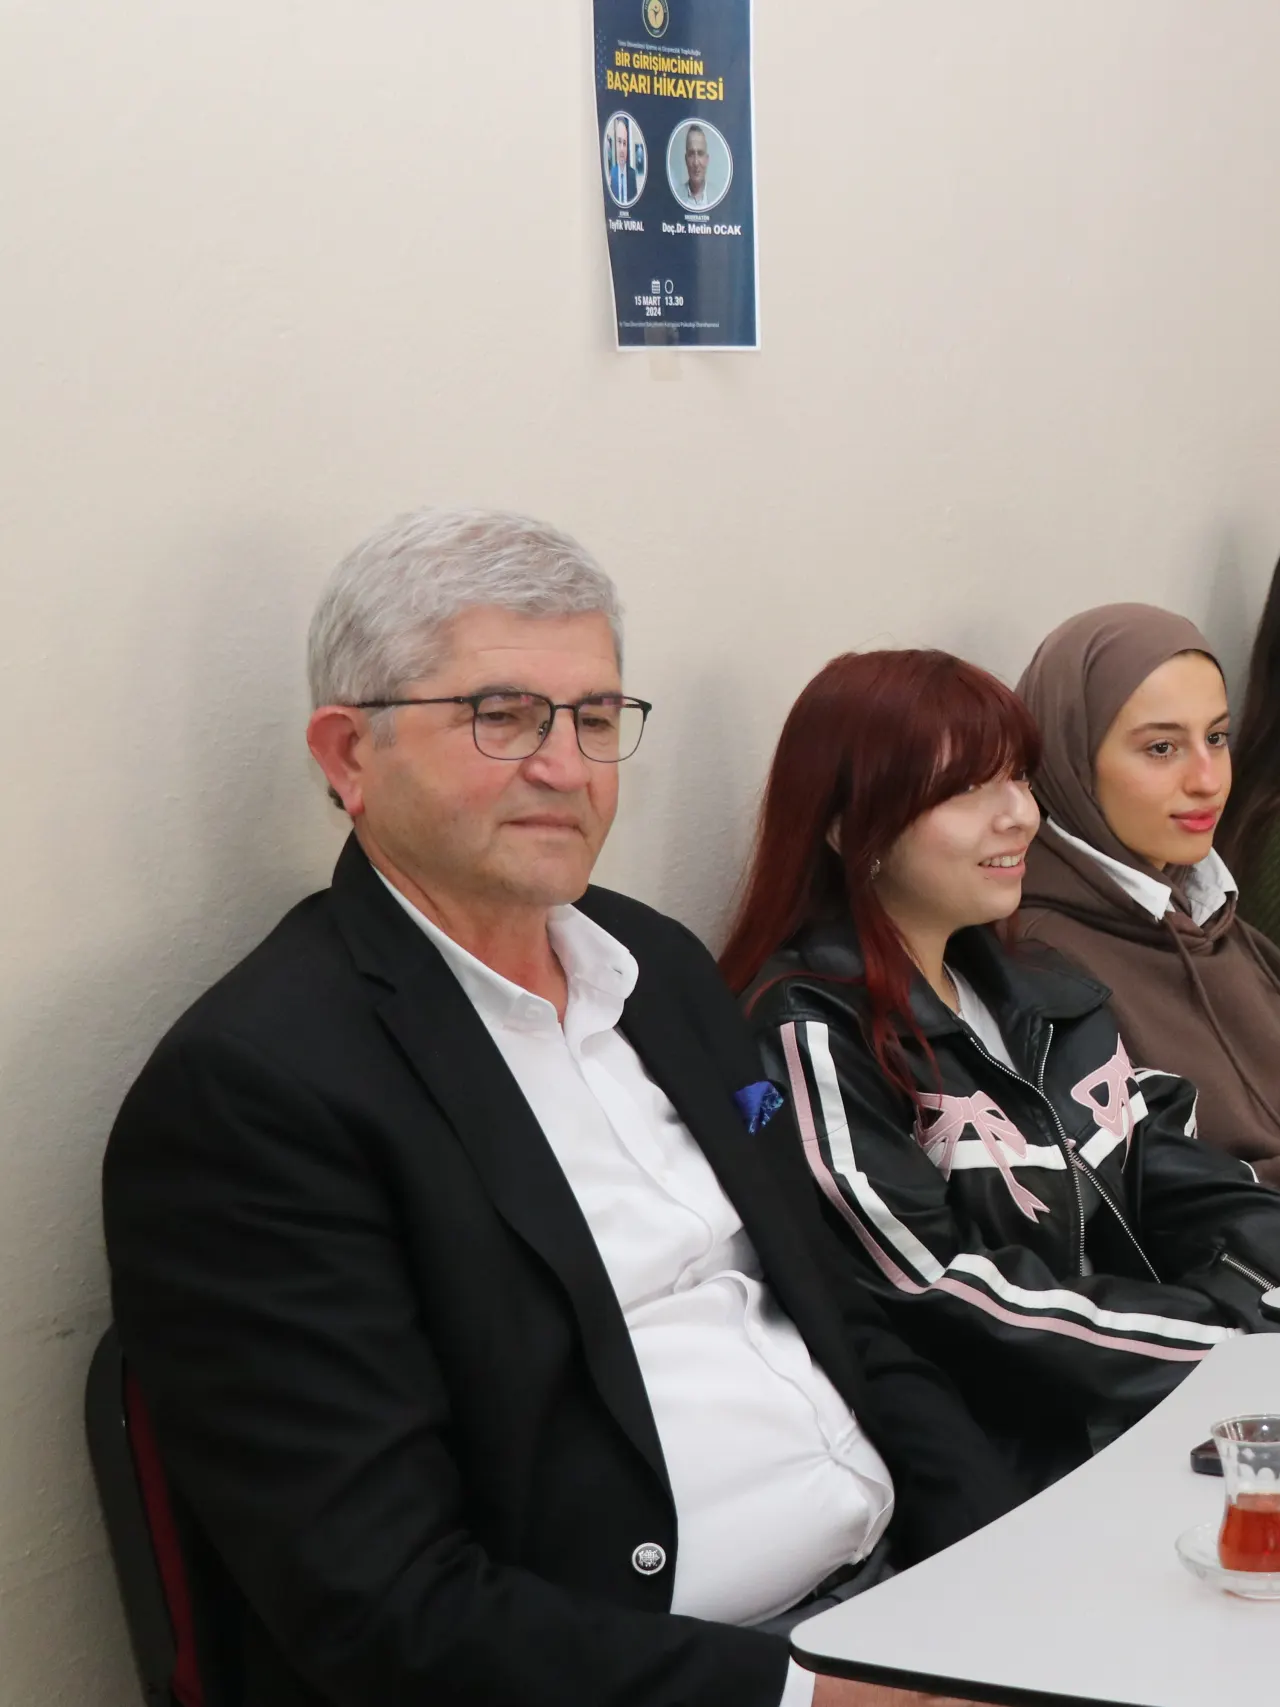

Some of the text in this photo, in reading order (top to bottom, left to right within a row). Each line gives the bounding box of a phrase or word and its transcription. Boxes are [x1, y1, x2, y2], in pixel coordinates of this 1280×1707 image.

[615, 49, 704, 76] BİR GİRİŞİMCİNİN
[607, 70, 724, 101] BAŞARI HİKAYESİ
[624, 220, 645, 231] VURAL
[688, 223, 712, 234] Metin
[713, 224, 742, 235] OCAK
[635, 296, 661, 306] 15 MART
[665, 296, 684, 306] 13.30
[646, 306, 661, 317] 2024
